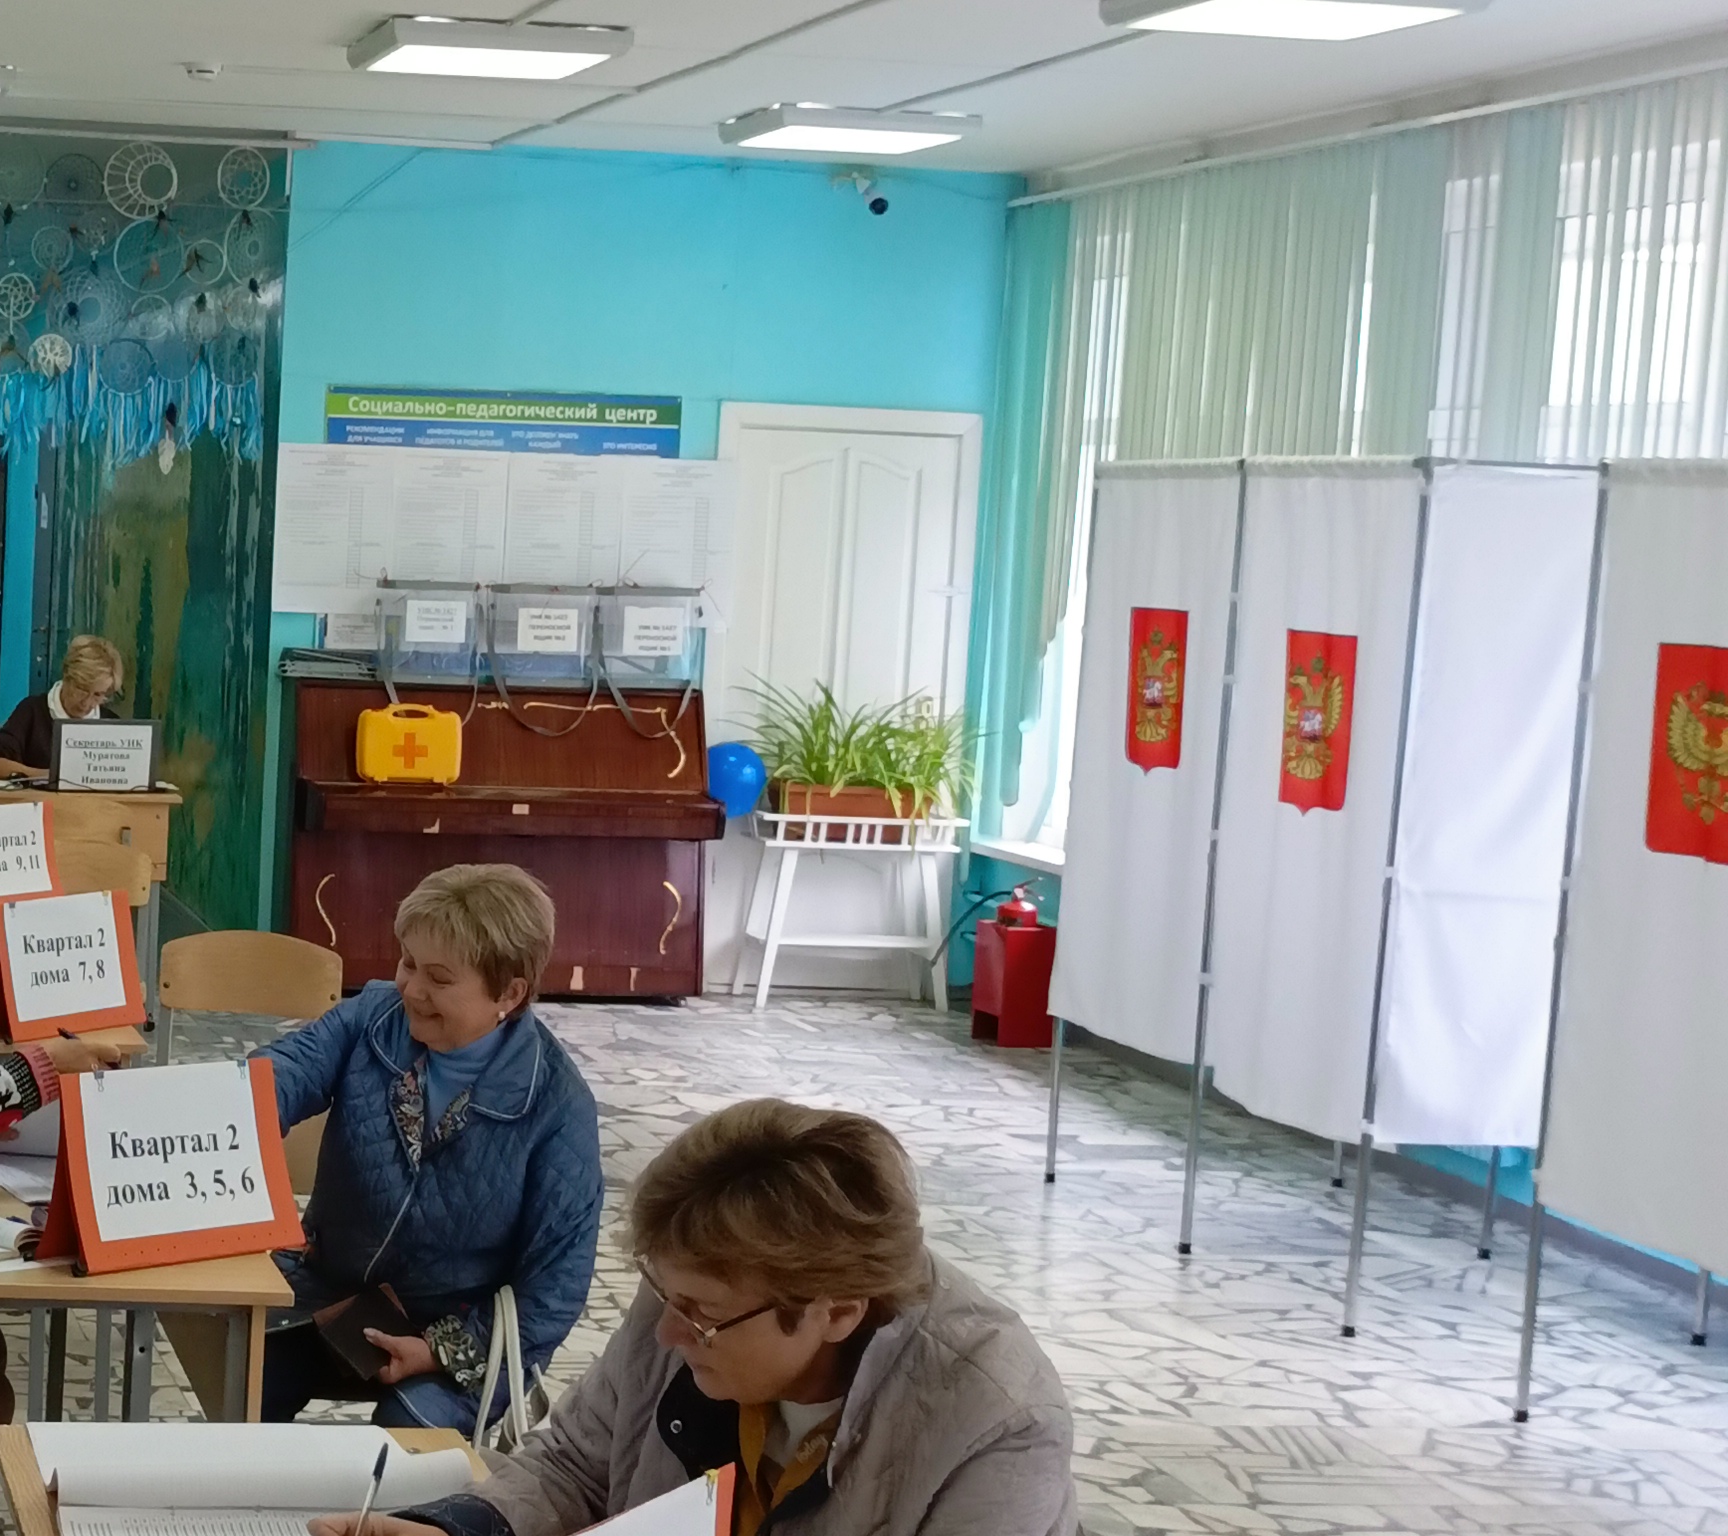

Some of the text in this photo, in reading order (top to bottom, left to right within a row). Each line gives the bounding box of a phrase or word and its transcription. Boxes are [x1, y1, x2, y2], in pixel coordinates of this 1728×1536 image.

[347, 395, 658, 425] Социально-педагогический центр
[65, 737, 117, 748] Секретарь
[30, 830, 37, 846] 2
[22, 927, 106, 957] Квартал 2
[30, 968, 70, 989] дома
[107, 1123, 240, 1164] Квартал 2
[106, 1166, 255, 1209] дома 3, 5, 6
